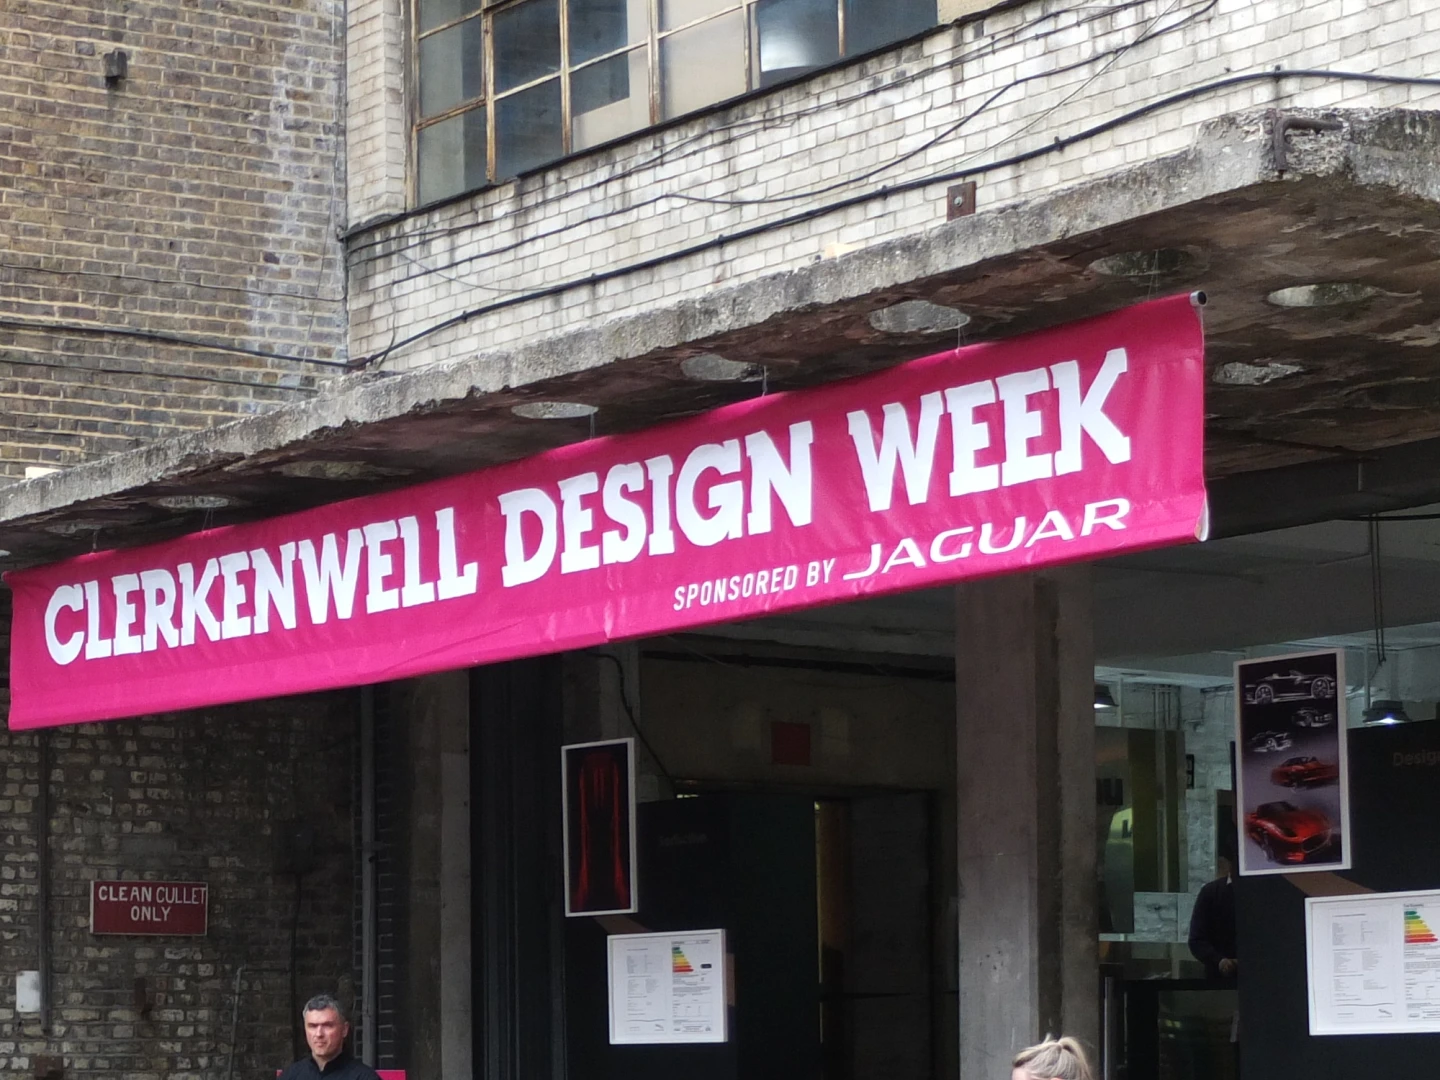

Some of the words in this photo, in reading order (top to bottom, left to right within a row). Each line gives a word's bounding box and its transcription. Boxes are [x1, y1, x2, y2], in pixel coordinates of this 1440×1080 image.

[44, 507, 477, 665] CLERKENWELL
[497, 420, 813, 588] DESIGN
[847, 347, 1131, 513] WEEK
[843, 498, 1131, 581] JAGUAR
[673, 564, 800, 611] SPONSORED
[805, 557, 836, 588] BY
[1392, 748, 1440, 767] Desig
[98, 885, 152, 902] CLEAN
[156, 886, 206, 904] CULLET
[130, 905, 171, 922] ONLY
